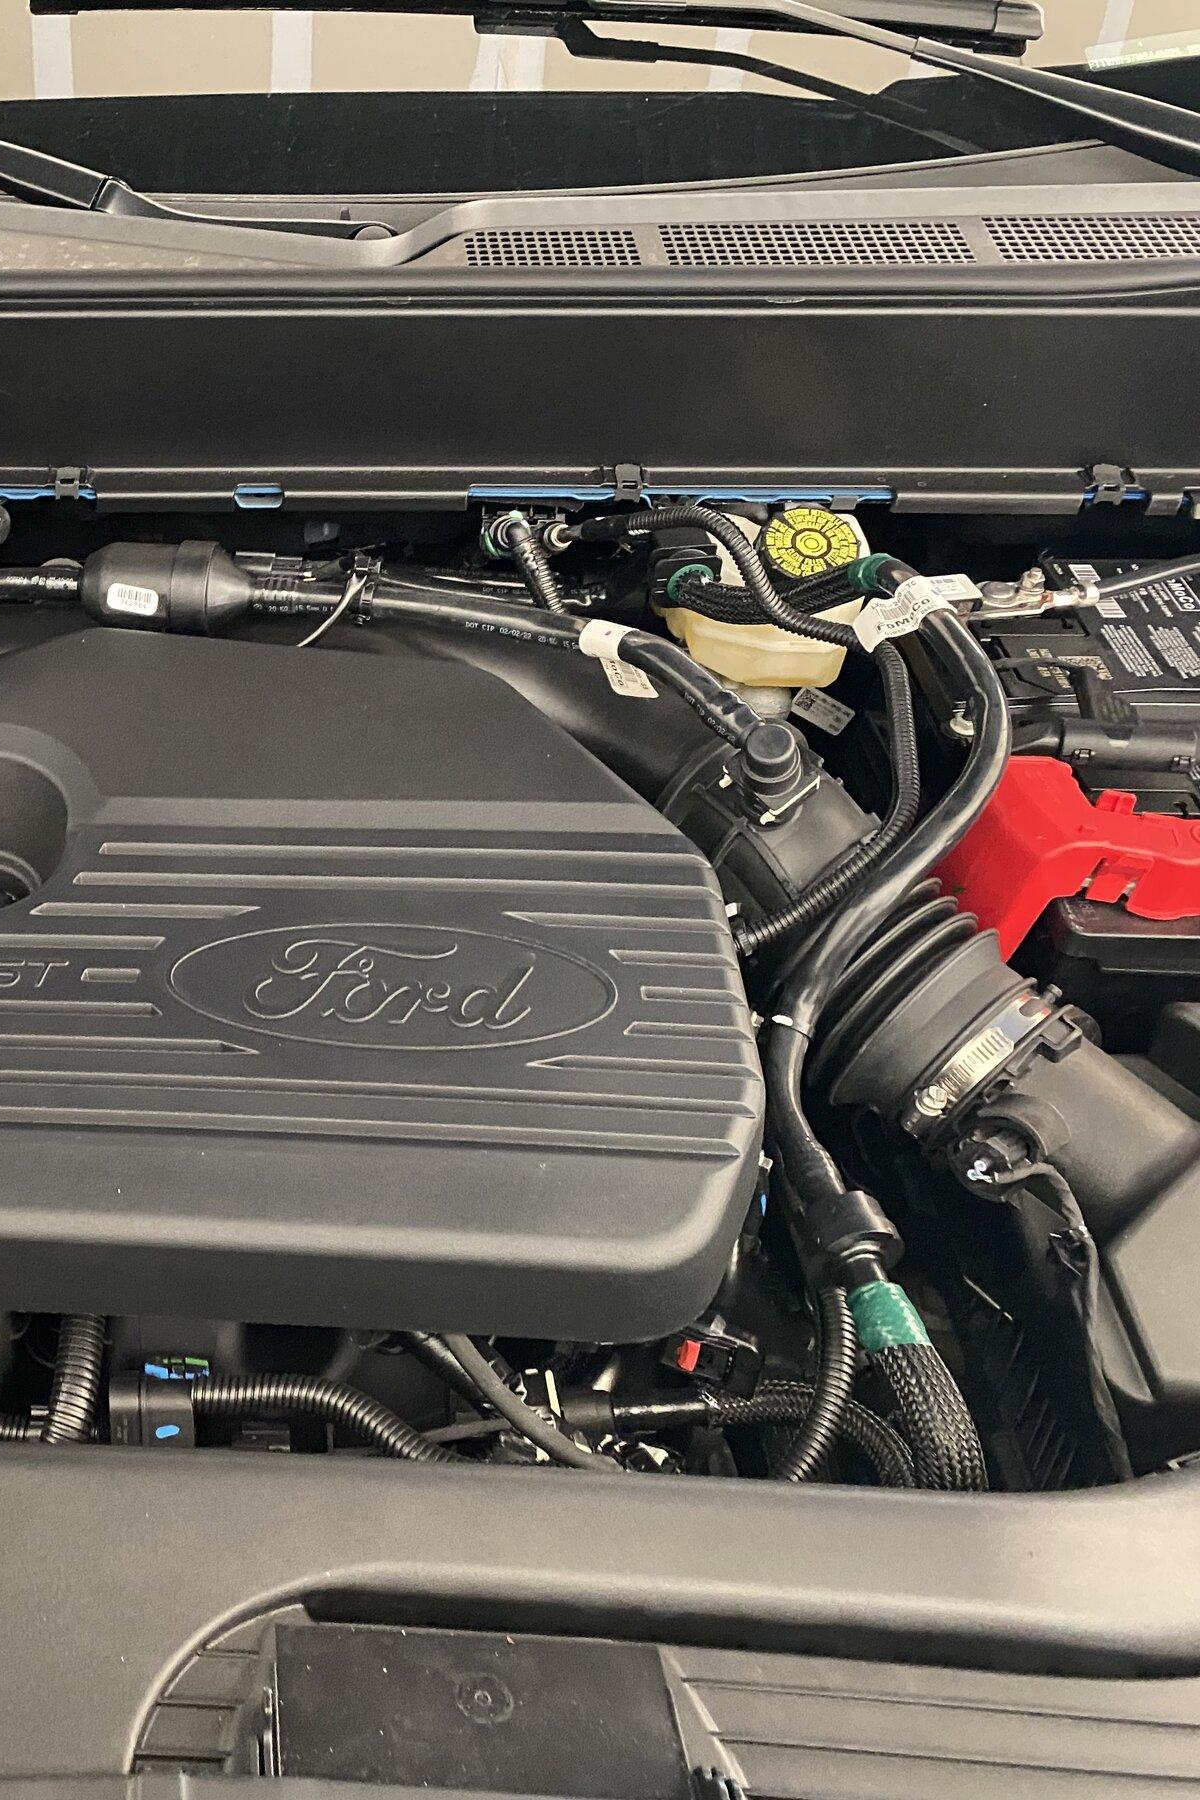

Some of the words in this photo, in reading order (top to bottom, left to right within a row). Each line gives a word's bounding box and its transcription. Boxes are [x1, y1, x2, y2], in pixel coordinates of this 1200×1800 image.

[465, 621, 479, 630] DOT
[482, 623, 496, 632] CIP
[499, 627, 532, 640] 02/02/22
[242, 937, 537, 1031] Ford
